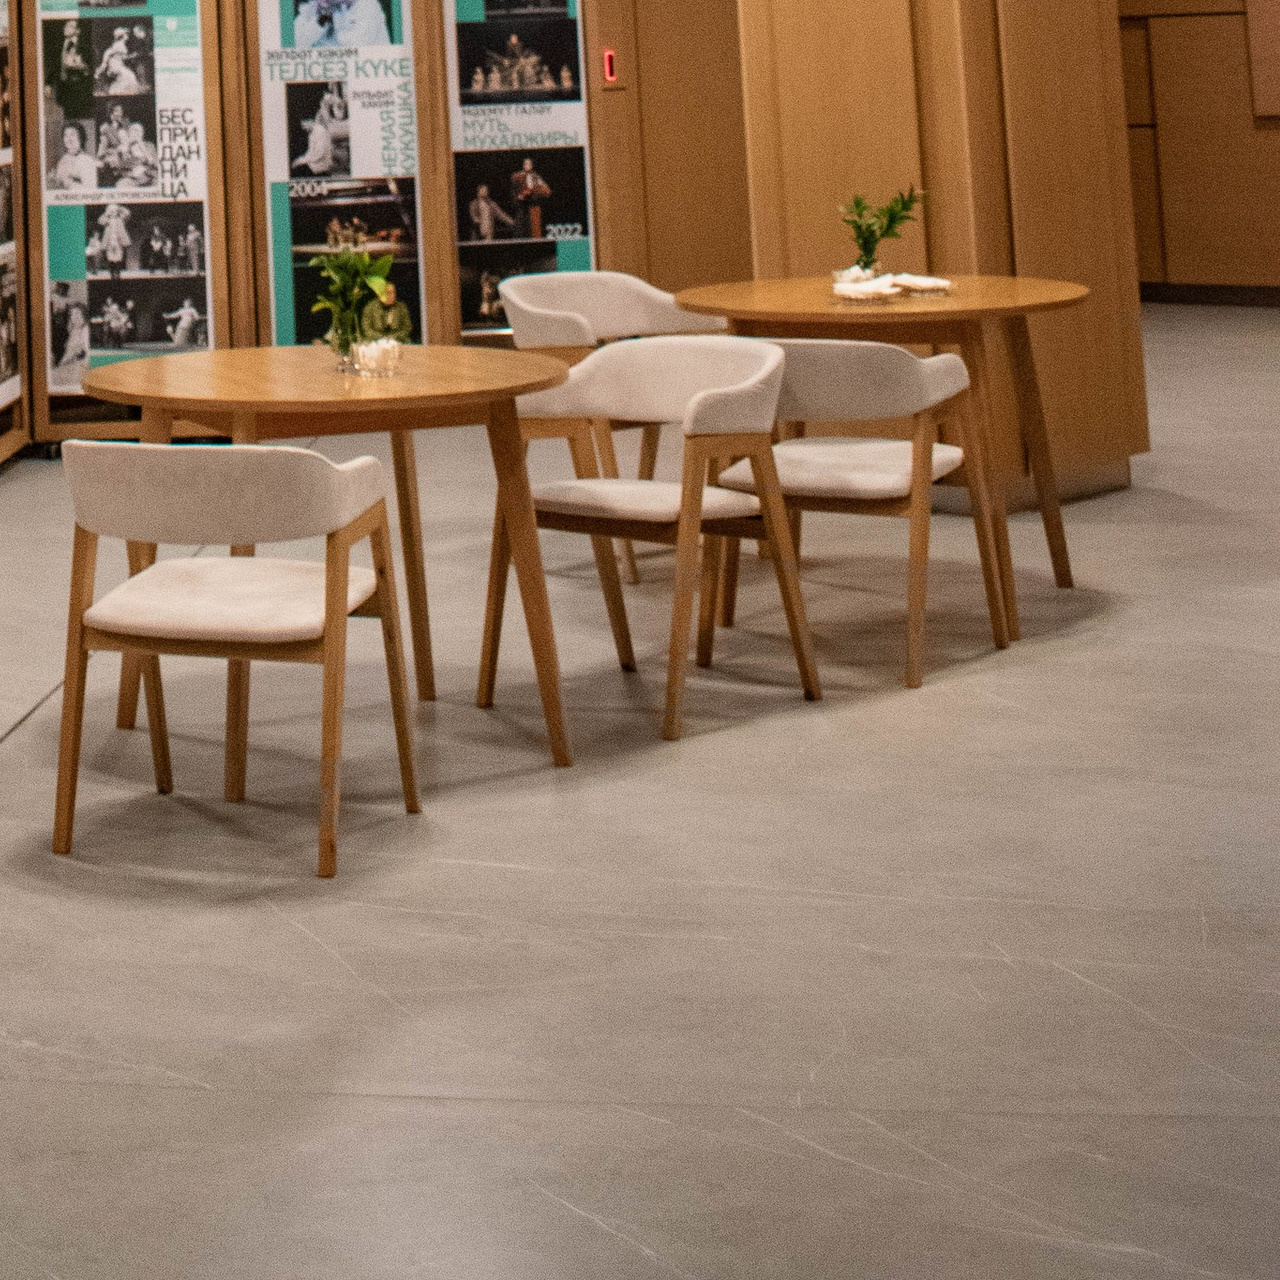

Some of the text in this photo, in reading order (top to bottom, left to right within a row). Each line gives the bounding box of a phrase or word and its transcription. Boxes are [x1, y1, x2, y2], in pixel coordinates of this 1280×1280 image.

[266, 59, 349, 81] ТЕЛСЕЗ
[159, 108, 194, 125] БЕС
[160, 126, 198, 142] ПРИ
[161, 145, 200, 164] ДАН
[162, 162, 188, 178] НИ
[162, 180, 188, 201] ЦА
